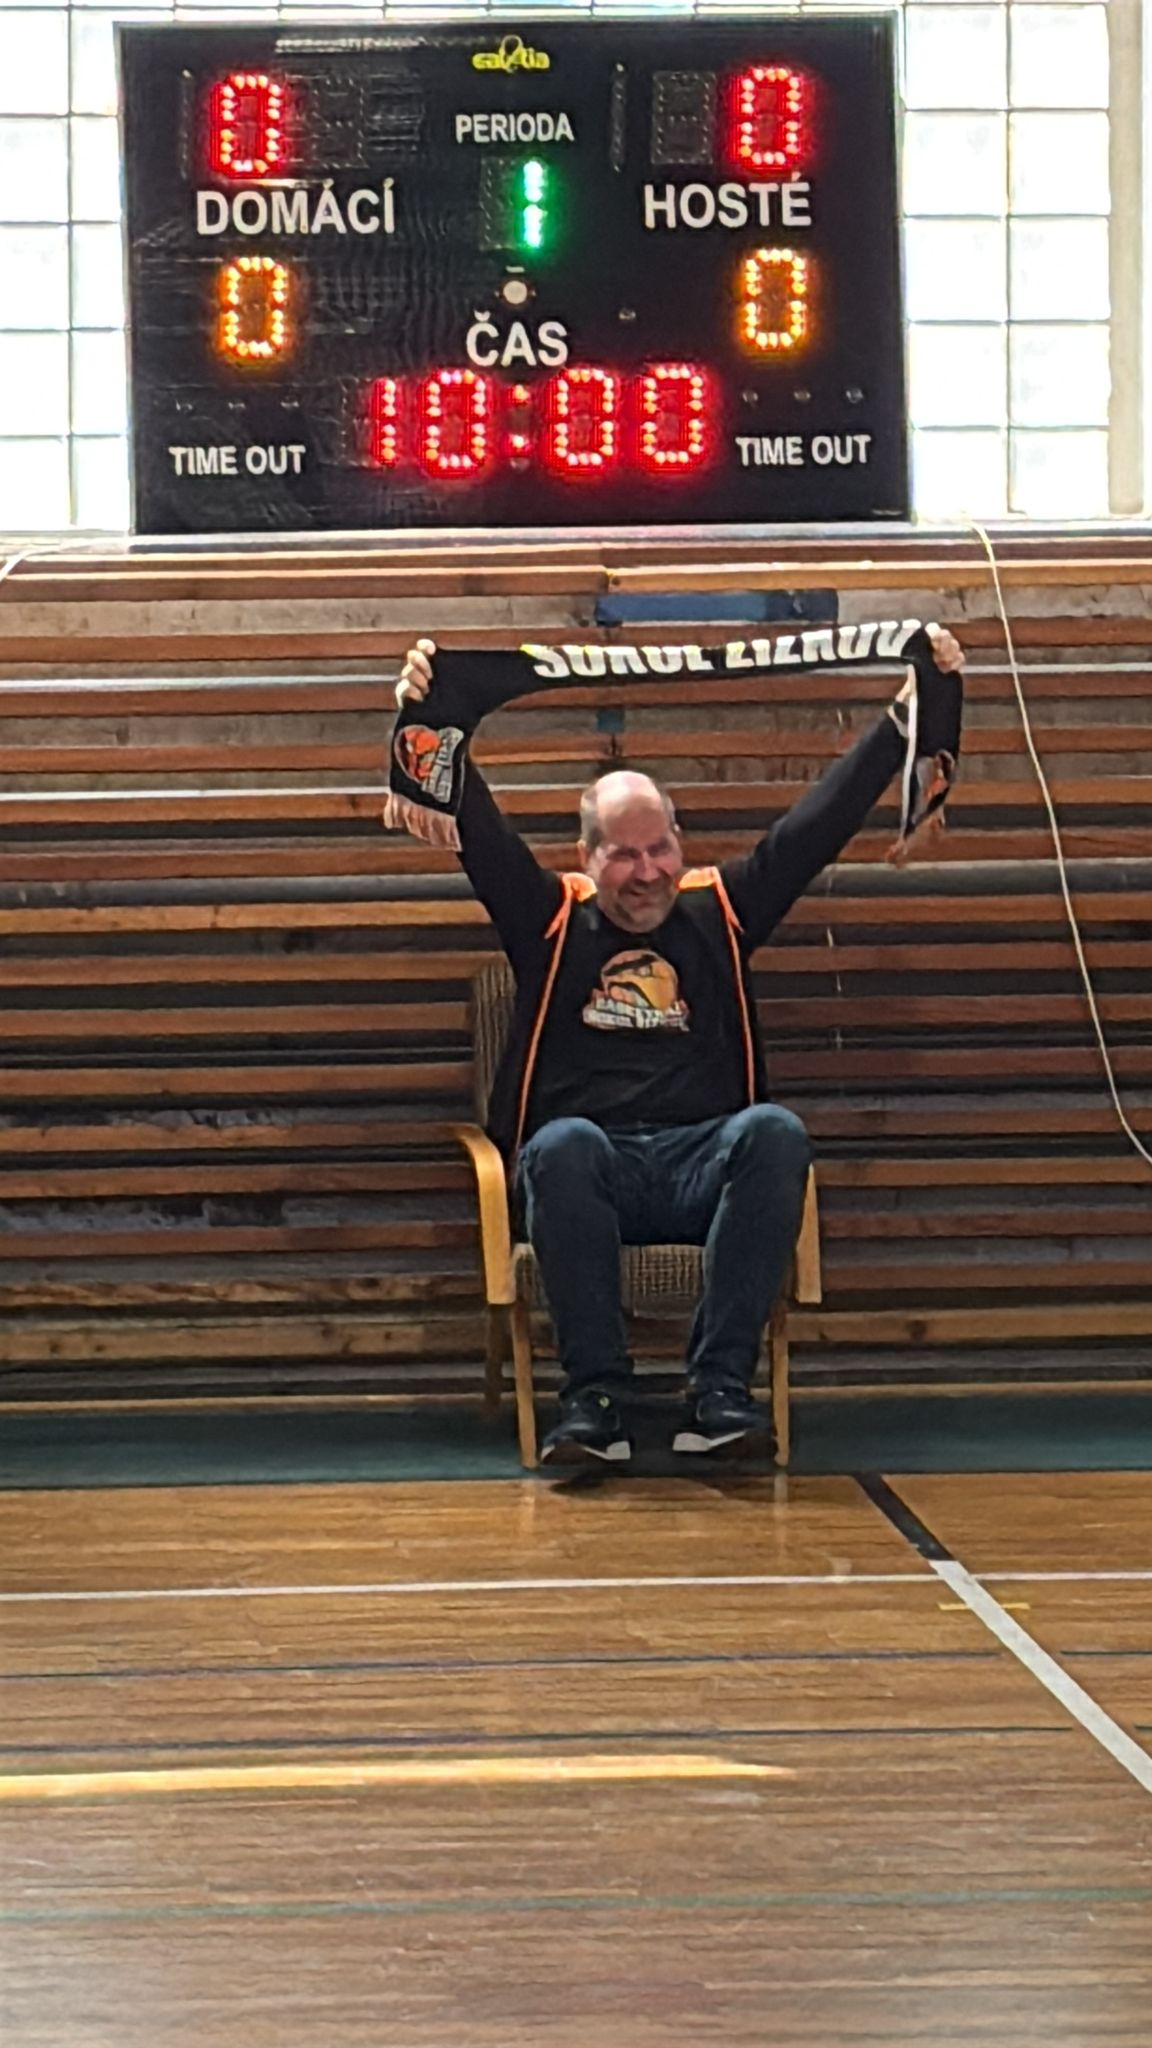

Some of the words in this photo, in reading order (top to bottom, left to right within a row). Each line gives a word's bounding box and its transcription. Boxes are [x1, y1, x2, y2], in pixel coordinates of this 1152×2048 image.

[217, 72, 284, 176] 0
[455, 113, 574, 144] PERIODA
[735, 66, 803, 167] 0
[195, 177, 395, 236] DOMÁCÍ
[522, 159, 544, 248] 1
[643, 171, 811, 229] HOSTÉ
[222, 256, 289, 357] 0
[742, 248, 807, 348] 0
[465, 310, 568, 367] ČAS
[374, 366, 706, 471] 10:00
[736, 437, 803, 467] TIME
[811, 434, 872, 466] OUT
[168, 446, 237, 476] TIME
[245, 445, 306, 475] OUT
